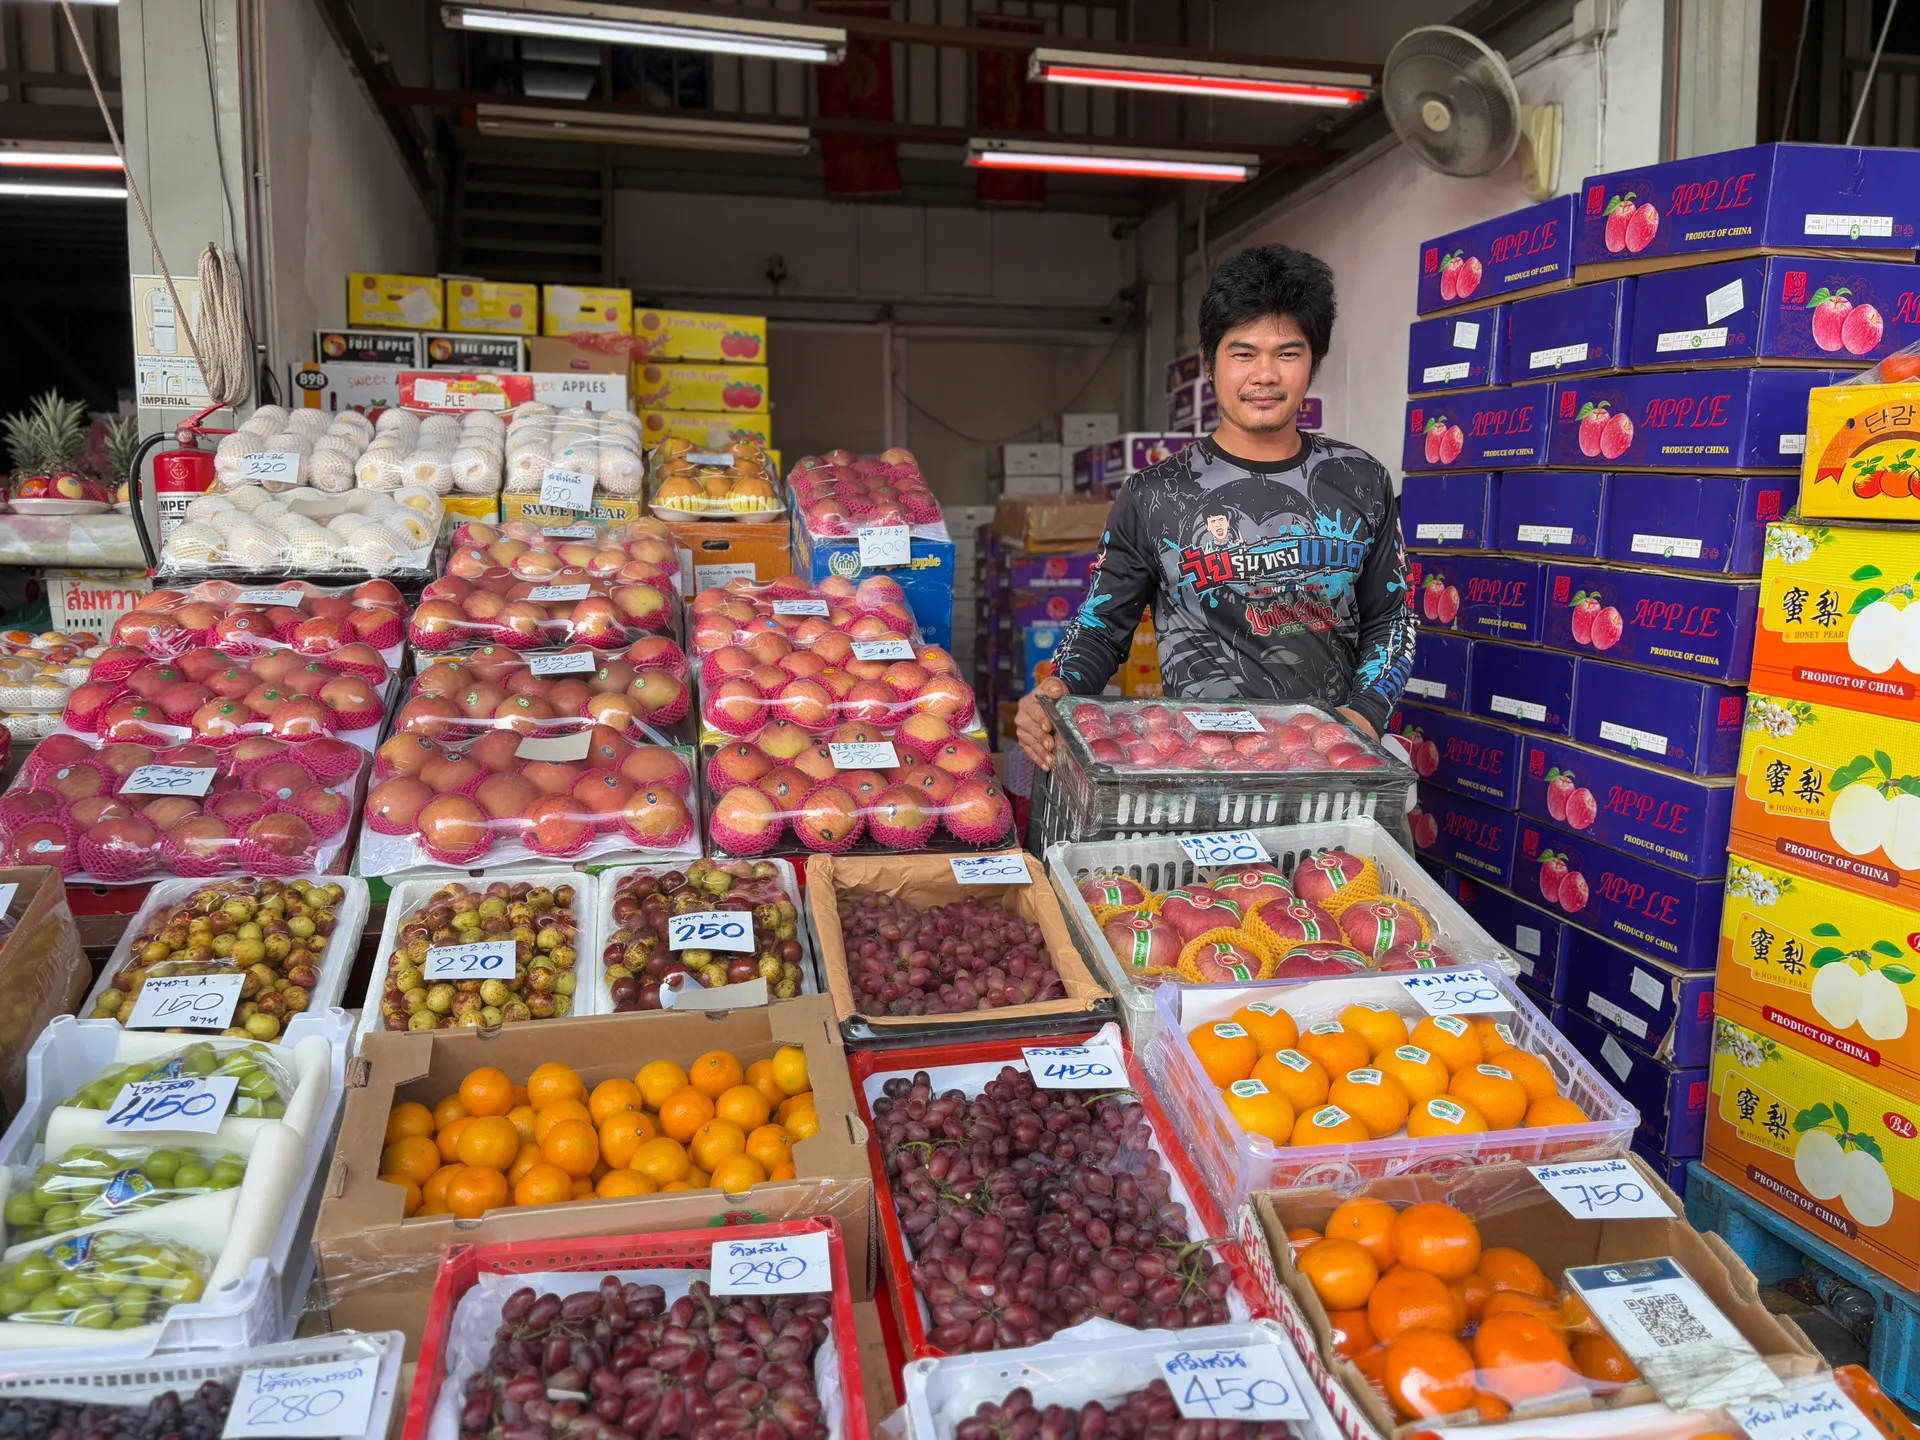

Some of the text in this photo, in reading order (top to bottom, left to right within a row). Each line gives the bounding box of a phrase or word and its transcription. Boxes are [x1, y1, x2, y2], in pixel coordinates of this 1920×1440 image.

[1666, 173, 1756, 217] APPLE
[1488, 220, 1558, 265] APPLE
[1686, 226, 1753, 242] PRODUCE OF CHINA
[1504, 263, 1559, 283] PRODUCE OF CHINA
[668, 316, 728, 332] Fresh Apple
[376, 339, 411, 351] APPLE
[480, 344, 514, 356] APPLE
[299, 373, 325, 386] 898
[347, 373, 389, 388] sweet
[669, 368, 729, 384] Fresh Apple
[562, 381, 607, 394] APPLES
[141, 396, 191, 406] IMPERIAL
[1469, 406, 1534, 437] APPLE
[1641, 395, 1731, 429] APPLE
[1864, 404, 1917, 434] 단감
[1483, 447, 1534, 458] PRODUCE OF CHINA
[1661, 446, 1730, 455] PRODUCE OF CHINA
[245, 462, 287, 476] 320
[541, 484, 572, 503] 350
[522, 503, 577, 520] SWEET
[584, 507, 627, 522] PEAR
[861, 539, 906, 560] 500
[900, 554, 942, 570] pple
[1470, 577, 1527, 607] APPLE
[1782, 586, 1845, 627] 蜜梨
[1478, 616, 1527, 631] PRODUCE OF CHINA
[1630, 599, 1721, 638] APPLE
[1794, 630, 1845, 639] HONEY PEAR
[1650, 646, 1720, 666] PRODUCE OF CHINA
[1800, 669, 1905, 696] PRODUCT OF CHINA
[1199, 719, 1252, 728] 500
[837, 751, 891, 766] 380
[1443, 736, 1504, 775] APPLE
[130, 776, 192, 791] 320
[1457, 777, 1479, 790] PRODUCE
[1485, 786, 1504, 798] CHINA
[1765, 758, 1826, 805] 蜜梨
[1604, 785, 1690, 835] APPLE
[1776, 803, 1827, 818] HONEY PEAR
[1442, 811, 1503, 852] APPLE
[1195, 845, 1258, 863] 400
[1623, 833, 1689, 863] PRODUCE OF CHINA
[961, 866, 1023, 879] 300
[1455, 851, 1478, 868] PRODUCE
[1484, 863, 1502, 876] CHINA
[1784, 842, 1891, 883] PRODUCT OF CHINA
[1595, 871, 1682, 926] APPLE
[674, 922, 745, 943] 250
[1613, 920, 1679, 954] PRODUCE OF CHINA
[1750, 926, 1808, 976] 蜜梨
[434, 954, 504, 973] 220
[1760, 971, 1809, 990] HONEY PEAR
[152, 993, 224, 1017] 150
[1427, 989, 1500, 1010] 300
[1770, 1011, 1872, 1063] PRODUCT OF CHINA
[1043, 1063, 1113, 1080] 450
[106, 1092, 217, 1128] 450
[1736, 1087, 1790, 1141] 蜜梨
[1745, 1130, 1793, 1155] HONEY PEAR
[1560, 1182, 1645, 1212] 750
[1753, 1170, 1849, 1234] PRODUCT OF CHINA
[728, 1256, 808, 1286] 280
[1183, 1375, 1290, 1417] 450
[246, 1389, 345, 1426] 280
